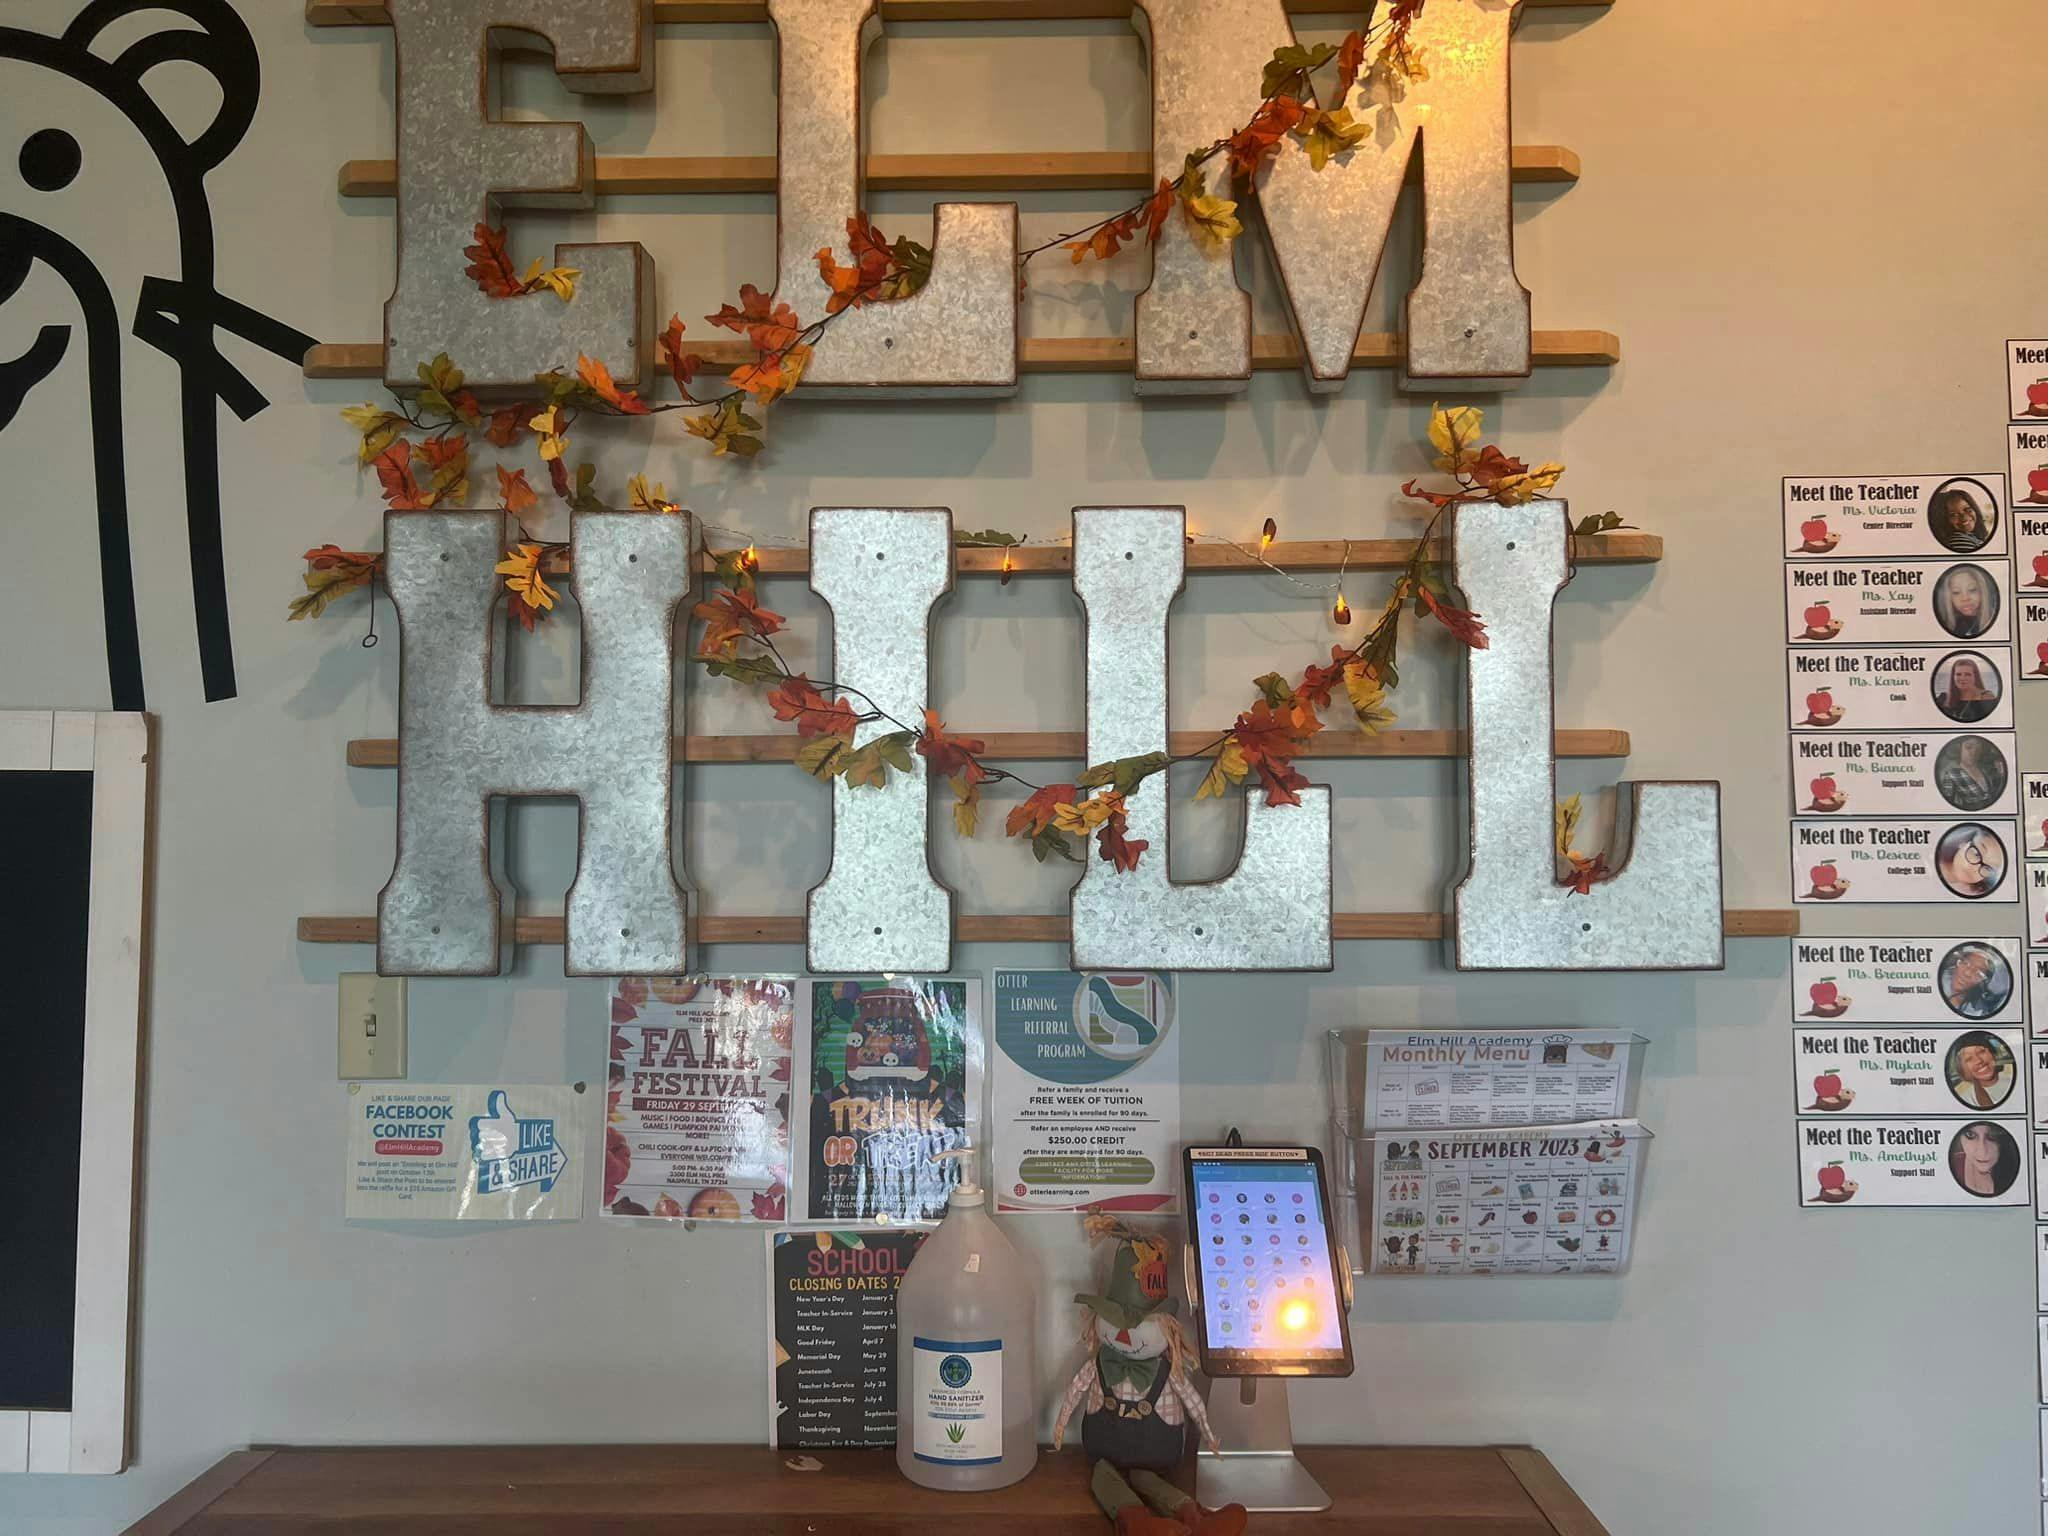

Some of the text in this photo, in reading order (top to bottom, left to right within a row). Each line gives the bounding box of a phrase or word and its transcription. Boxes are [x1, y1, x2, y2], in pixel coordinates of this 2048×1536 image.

[384, 0, 1531, 396] ELM
[2017, 433, 2048, 449] Mee
[1791, 484, 1920, 501] Meet the Teacher
[1842, 505, 1917, 515] Ms. Victoria
[2021, 520, 2048, 536] Mee
[1793, 569, 1923, 586] Meet the Teacher
[1862, 591, 1885, 601] Ms.
[1796, 656, 1926, 672] Meet the Teacher
[1849, 677, 1872, 686] Ms.
[377, 498, 1724, 976] HILL
[1800, 741, 1927, 757] Meet the Teacher
[1846, 762, 1915, 772] Ms. Bianca
[1882, 780, 1907, 788] Support
[1800, 828, 1930, 844] Meet the Teacher
[1851, 850, 1921, 860] Ms. Desiree
[1799, 945, 1933, 962] Meet the Teacher
[1848, 969, 1929, 979] Ms. Breanna
[998, 975, 1028, 988] OTTER
[1888, 986, 1914, 994] Support
[1011, 998, 1058, 1011] LEARNING
[1024, 1021, 1069, 1034] REFERRAL
[640, 1028, 759, 1070] FALL
[1408, 1036, 1534, 1048] Elm Hill Academy
[1802, 1036, 1936, 1054] Meet the Teacher
[1038, 1044, 1086, 1058] PROGRAM
[1383, 1046, 1531, 1064] Monthly Menu
[1859, 1060, 1932, 1073] Ms. Mykah
[632, 1072, 767, 1097] FESTIVAL
[1890, 1077, 1934, 1086] Support Staff
[647, 1100, 695, 1111] FRIDAY 29
[1030, 1096, 1143, 1104] FREE WEEK OF TUITION
[366, 1105, 453, 1119] FACEBOOK
[829, 1096, 944, 1132] TRUNK
[373, 1124, 445, 1138] CONTEST
[523, 1125, 550, 1149] LIKE
[1807, 1128, 1941, 1145] Meet the Teacher
[1048, 1136, 1125, 1145] $250.00 CREDIT
[824, 1136, 857, 1167] OR
[1428, 1139, 1580, 1159] SEPTEMBER 2023
[1850, 1151, 1937, 1164] Ms. Amethyst
[492, 1152, 558, 1186] & SHARE
[1891, 1168, 1935, 1177] Support Staff
[808, 1248, 907, 1276] SCHOOL
[790, 1277, 842, 1290] CLOSING
[847, 1276, 888, 1290] DATES
[862, 1294, 887, 1302] January
[862, 1338, 878, 1346] April
[799, 1426, 840, 1434] Thanksgiving
